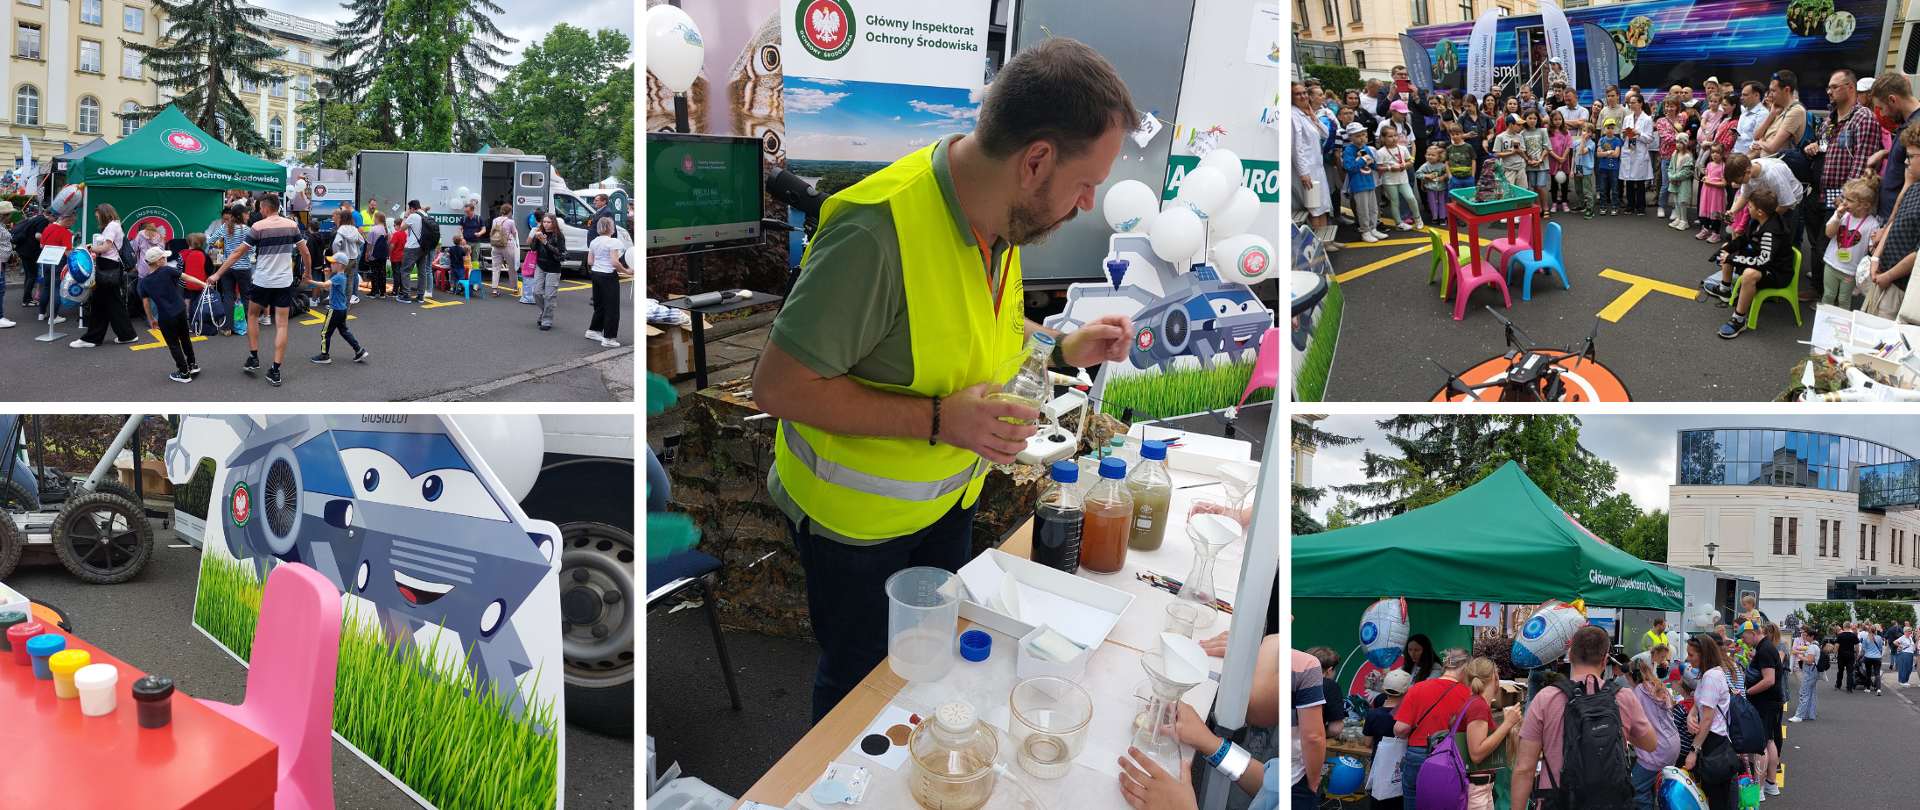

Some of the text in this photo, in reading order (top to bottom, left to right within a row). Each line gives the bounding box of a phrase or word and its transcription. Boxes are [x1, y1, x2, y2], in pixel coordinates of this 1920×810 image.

[865, 15, 974, 36] Główny Inspektorat
[799, 30, 853, 58] OCHRONY ŚRODOWISKA
[865, 31, 978, 52] Ochrony Środowiska
[97, 167, 280, 184] Główny Inspektorat Ochrony Środowiska
[135, 209, 168, 219] INSPEKCJA
[1588, 569, 1617, 590] Główny
[1616, 575, 1647, 591] Inspektorat
[1646, 581, 1664, 597] Ochrony
[1467, 601, 1492, 619] 14
